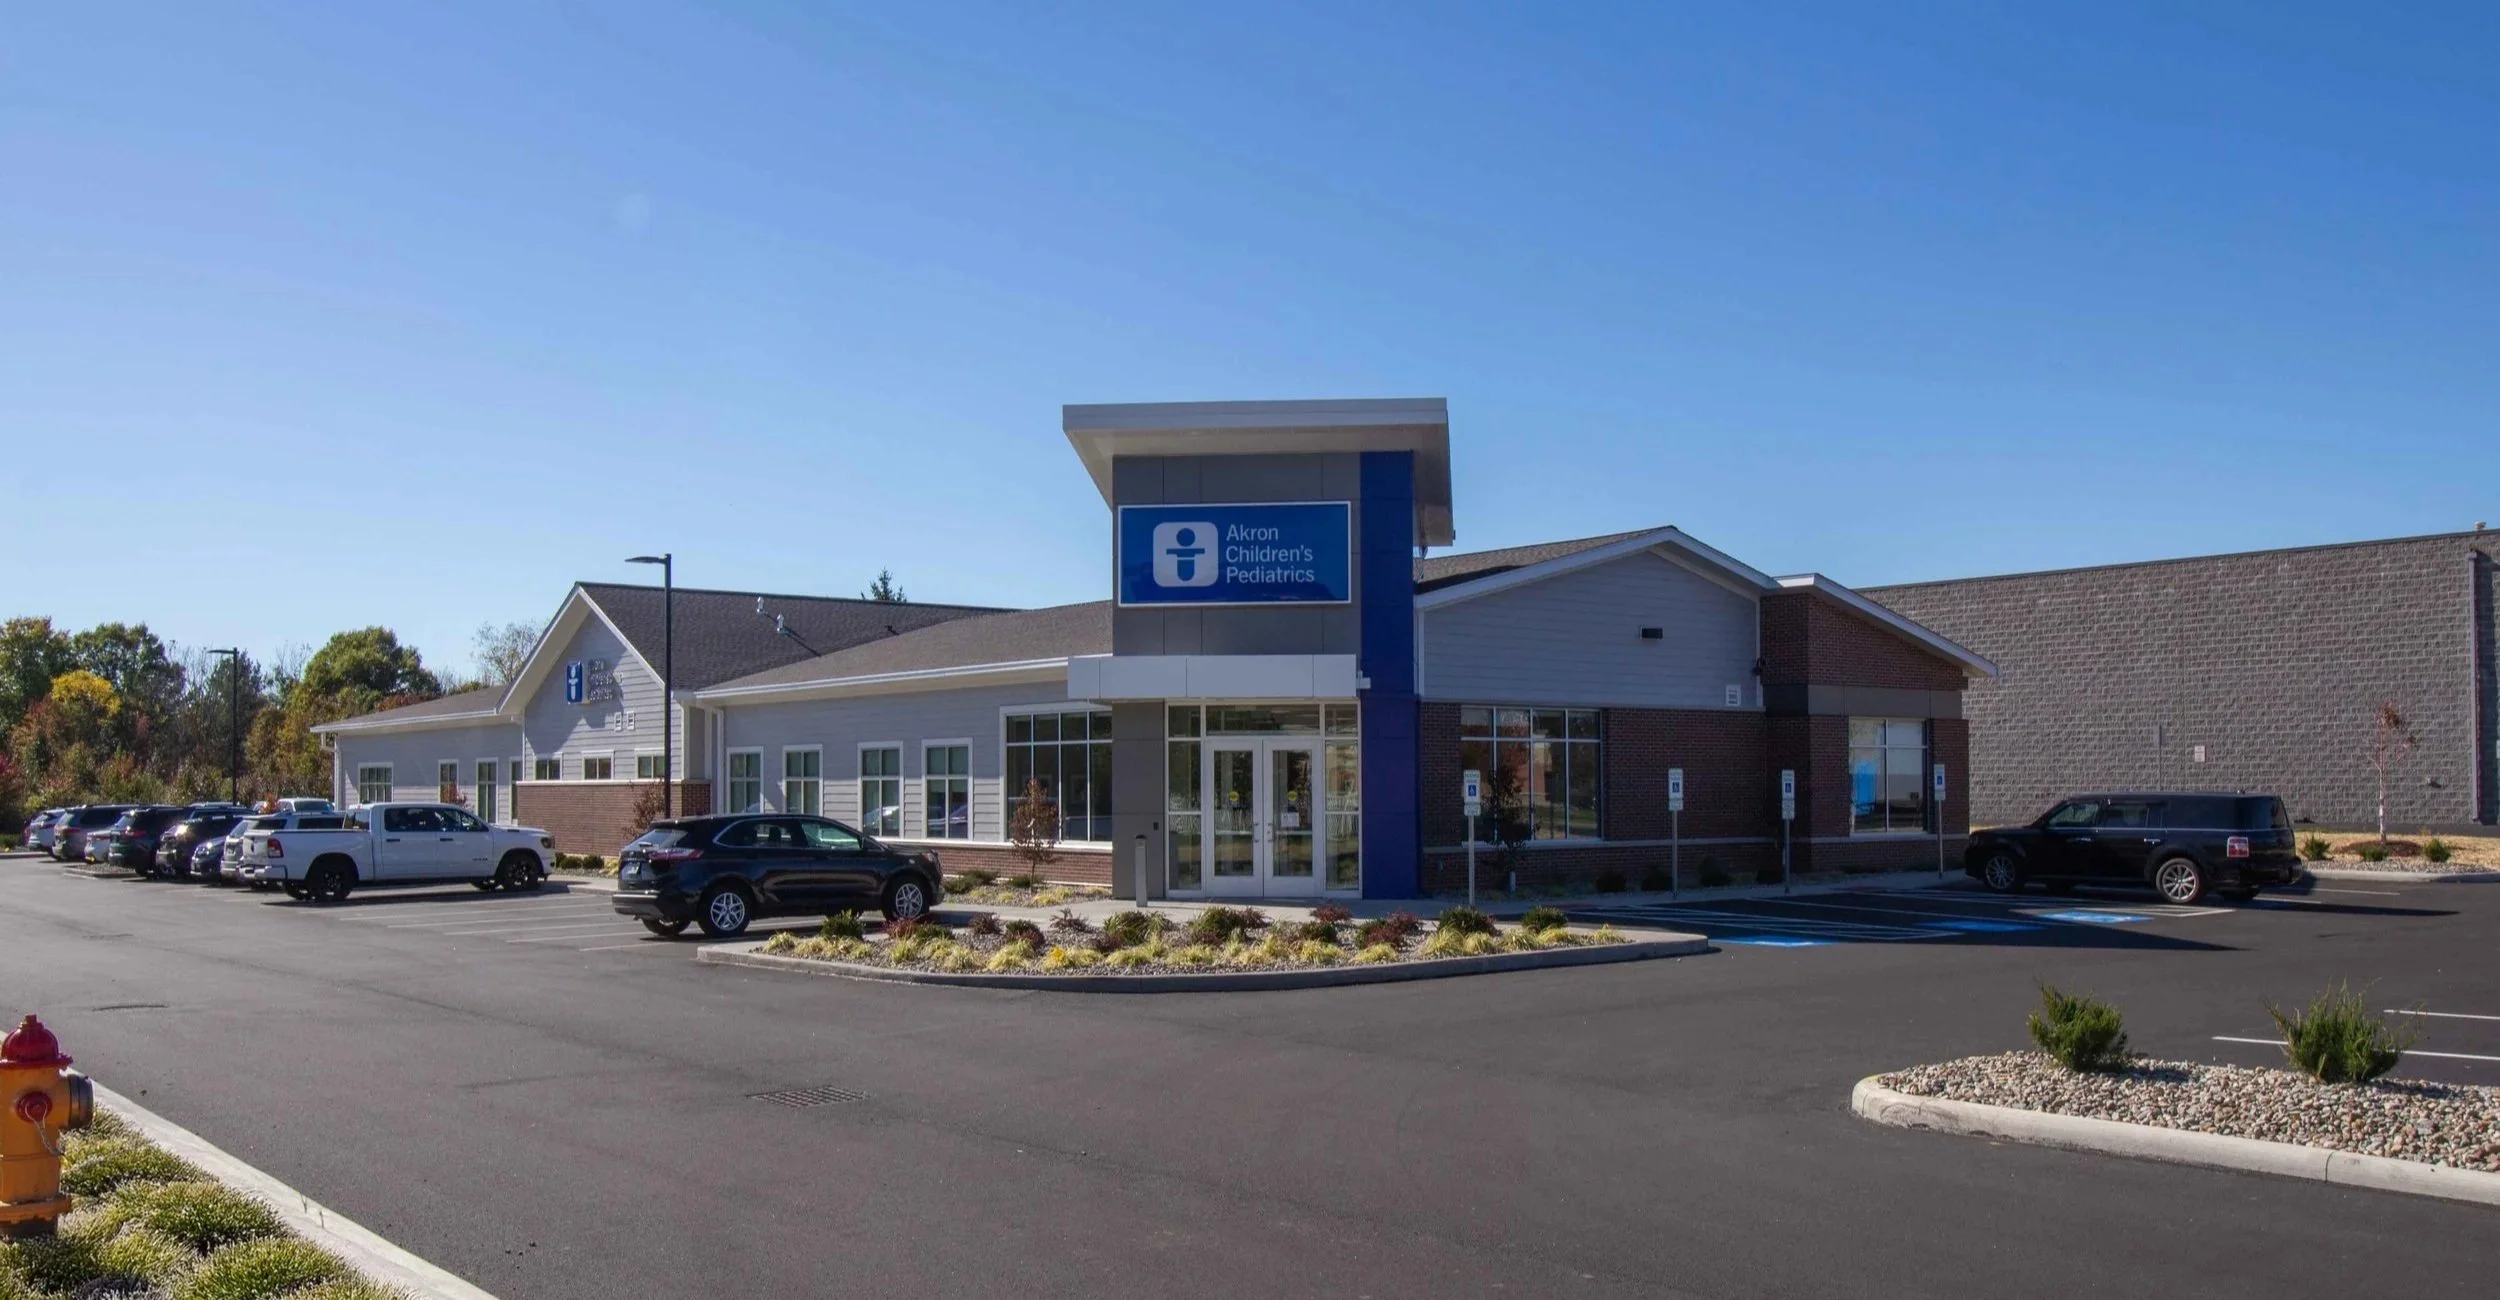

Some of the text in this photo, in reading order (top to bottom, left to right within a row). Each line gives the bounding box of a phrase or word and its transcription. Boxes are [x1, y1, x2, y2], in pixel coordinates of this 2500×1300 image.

[1226, 524, 1279, 541] Akron
[1226, 545, 1313, 562] Children's
[1226, 565, 1315, 584] Pediatrics
